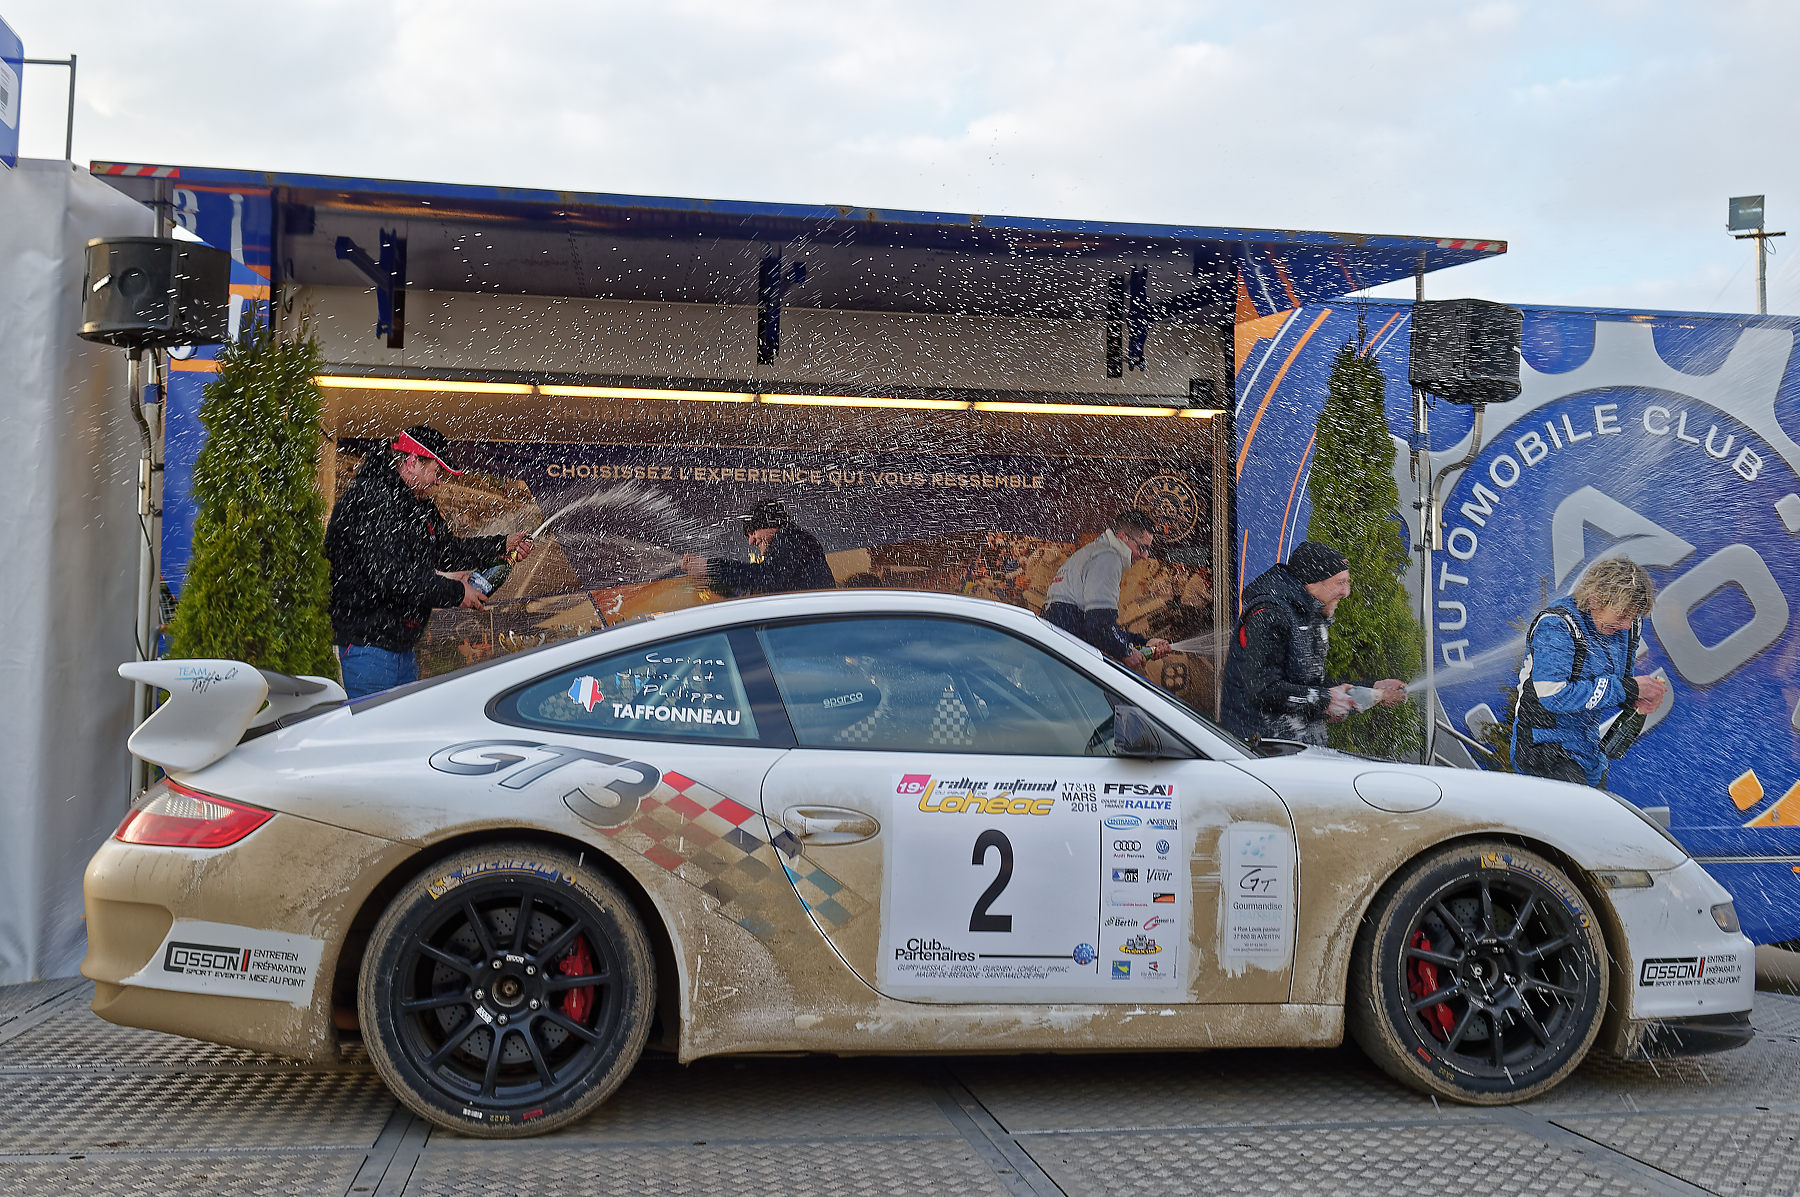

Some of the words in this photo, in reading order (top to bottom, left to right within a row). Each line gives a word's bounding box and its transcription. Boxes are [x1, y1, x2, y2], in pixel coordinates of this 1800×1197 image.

[547, 464, 672, 480] CHOISISSEZ
[828, 470, 863, 487] QUI
[871, 472, 925, 487] VOUS
[931, 474, 1044, 490] RESSEMBLE
[1438, 404, 1621, 671] AUTOMOBILE
[1643, 403, 1764, 482] CLUB
[179, 667, 207, 676] TEAM
[692, 671, 715, 682] et
[643, 684, 725, 704] Philippe
[822, 691, 864, 709] sparco
[612, 703, 741, 726] TAFFONNEAU
[428, 738, 661, 829] GT3
[938, 777, 988, 796] rallye
[1062, 783, 1096, 792] 17&18
[1103, 783, 1167, 797] FFSA
[918, 779, 1055, 815] Lohéac
[1061, 792, 1097, 802] MARS
[1124, 799, 1172, 810] RALLYE
[1071, 802, 1098, 813] 2018
[460, 860, 557, 878] MICHELIN
[969, 828, 1014, 933] 2
[1239, 868, 1276, 892] GT
[1510, 857, 1582, 912] MICHELIN
[1232, 901, 1283, 912] Gourmandise
[1114, 918, 1139, 927] Bertin
[906, 938, 942, 951] Club
[253, 949, 299, 962] ENTRETIEN
[895, 947, 976, 961] Partenaires
[185, 967, 213, 977] SPORT
[214, 970, 247, 982] EVENTS
[252, 961, 308, 976] PRÉPARATION
[248, 973, 269, 985] MISE
[269, 976, 282, 985] AU
[282, 978, 307, 989] POINT
